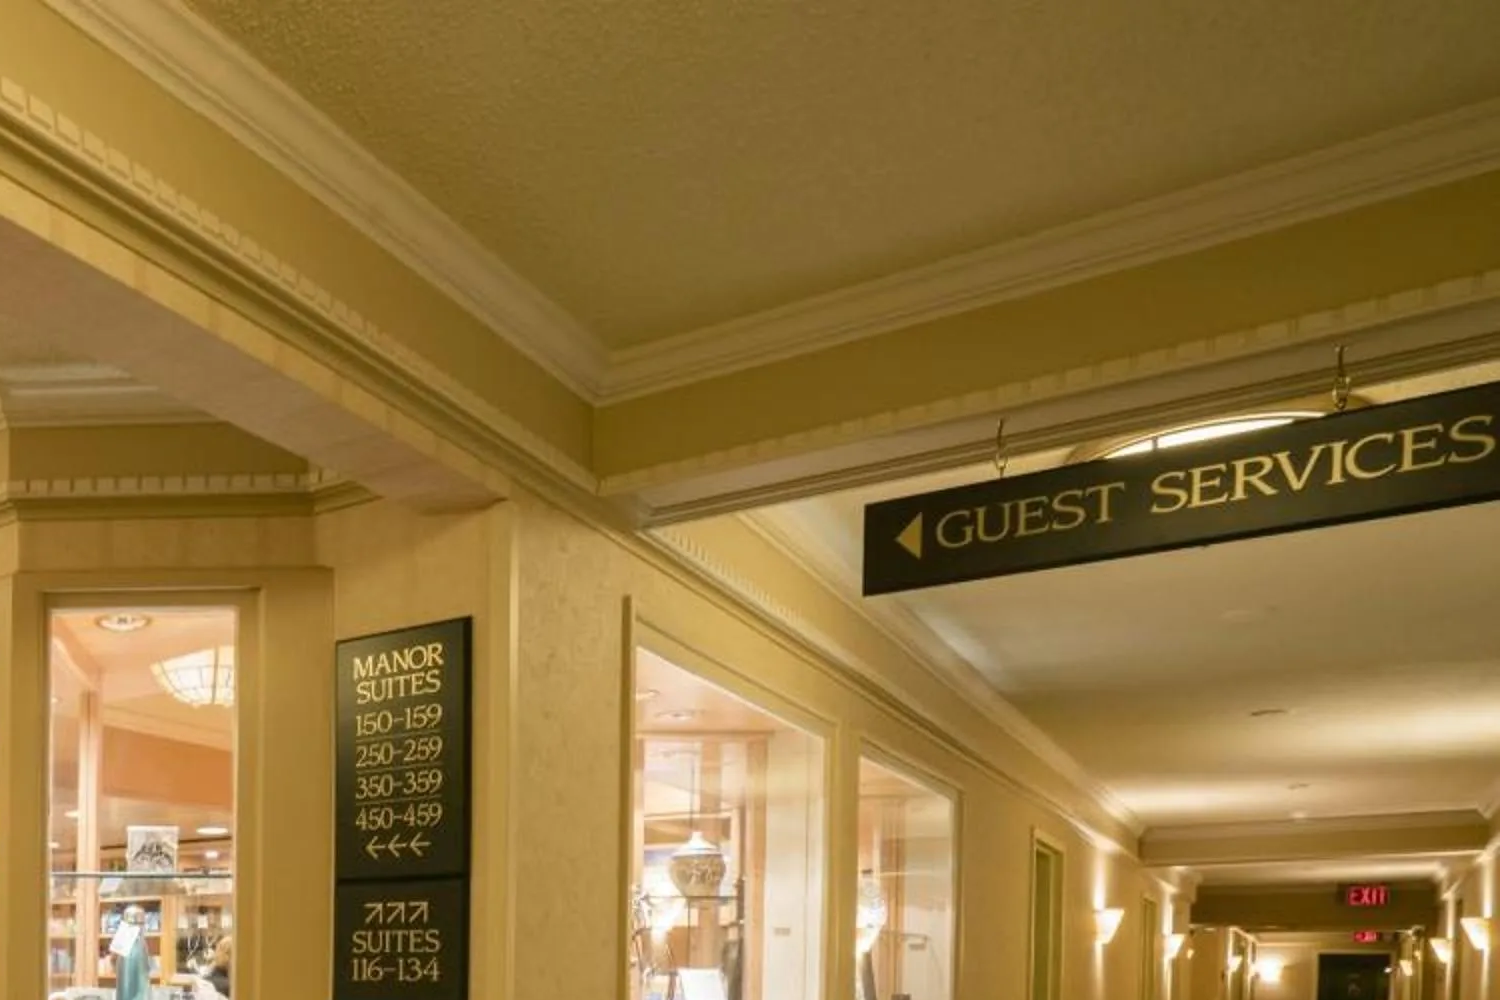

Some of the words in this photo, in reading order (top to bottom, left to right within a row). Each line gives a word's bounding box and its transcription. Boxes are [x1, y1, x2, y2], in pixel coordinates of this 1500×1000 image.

[936, 482, 1126, 550] GUEST
[1150, 415, 1498, 514] SERVICES
[353, 642, 445, 681] MANOR
[355, 669, 442, 705] SUITES
[355, 703, 443, 737] 150-159
[355, 736, 443, 768] 250-259
[355, 769, 443, 800] 350-359
[355, 803, 443, 831] 450-459
[1349, 886, 1385, 906] EXIT
[352, 929, 441, 953] SUITES
[351, 956, 441, 981] 116-134
